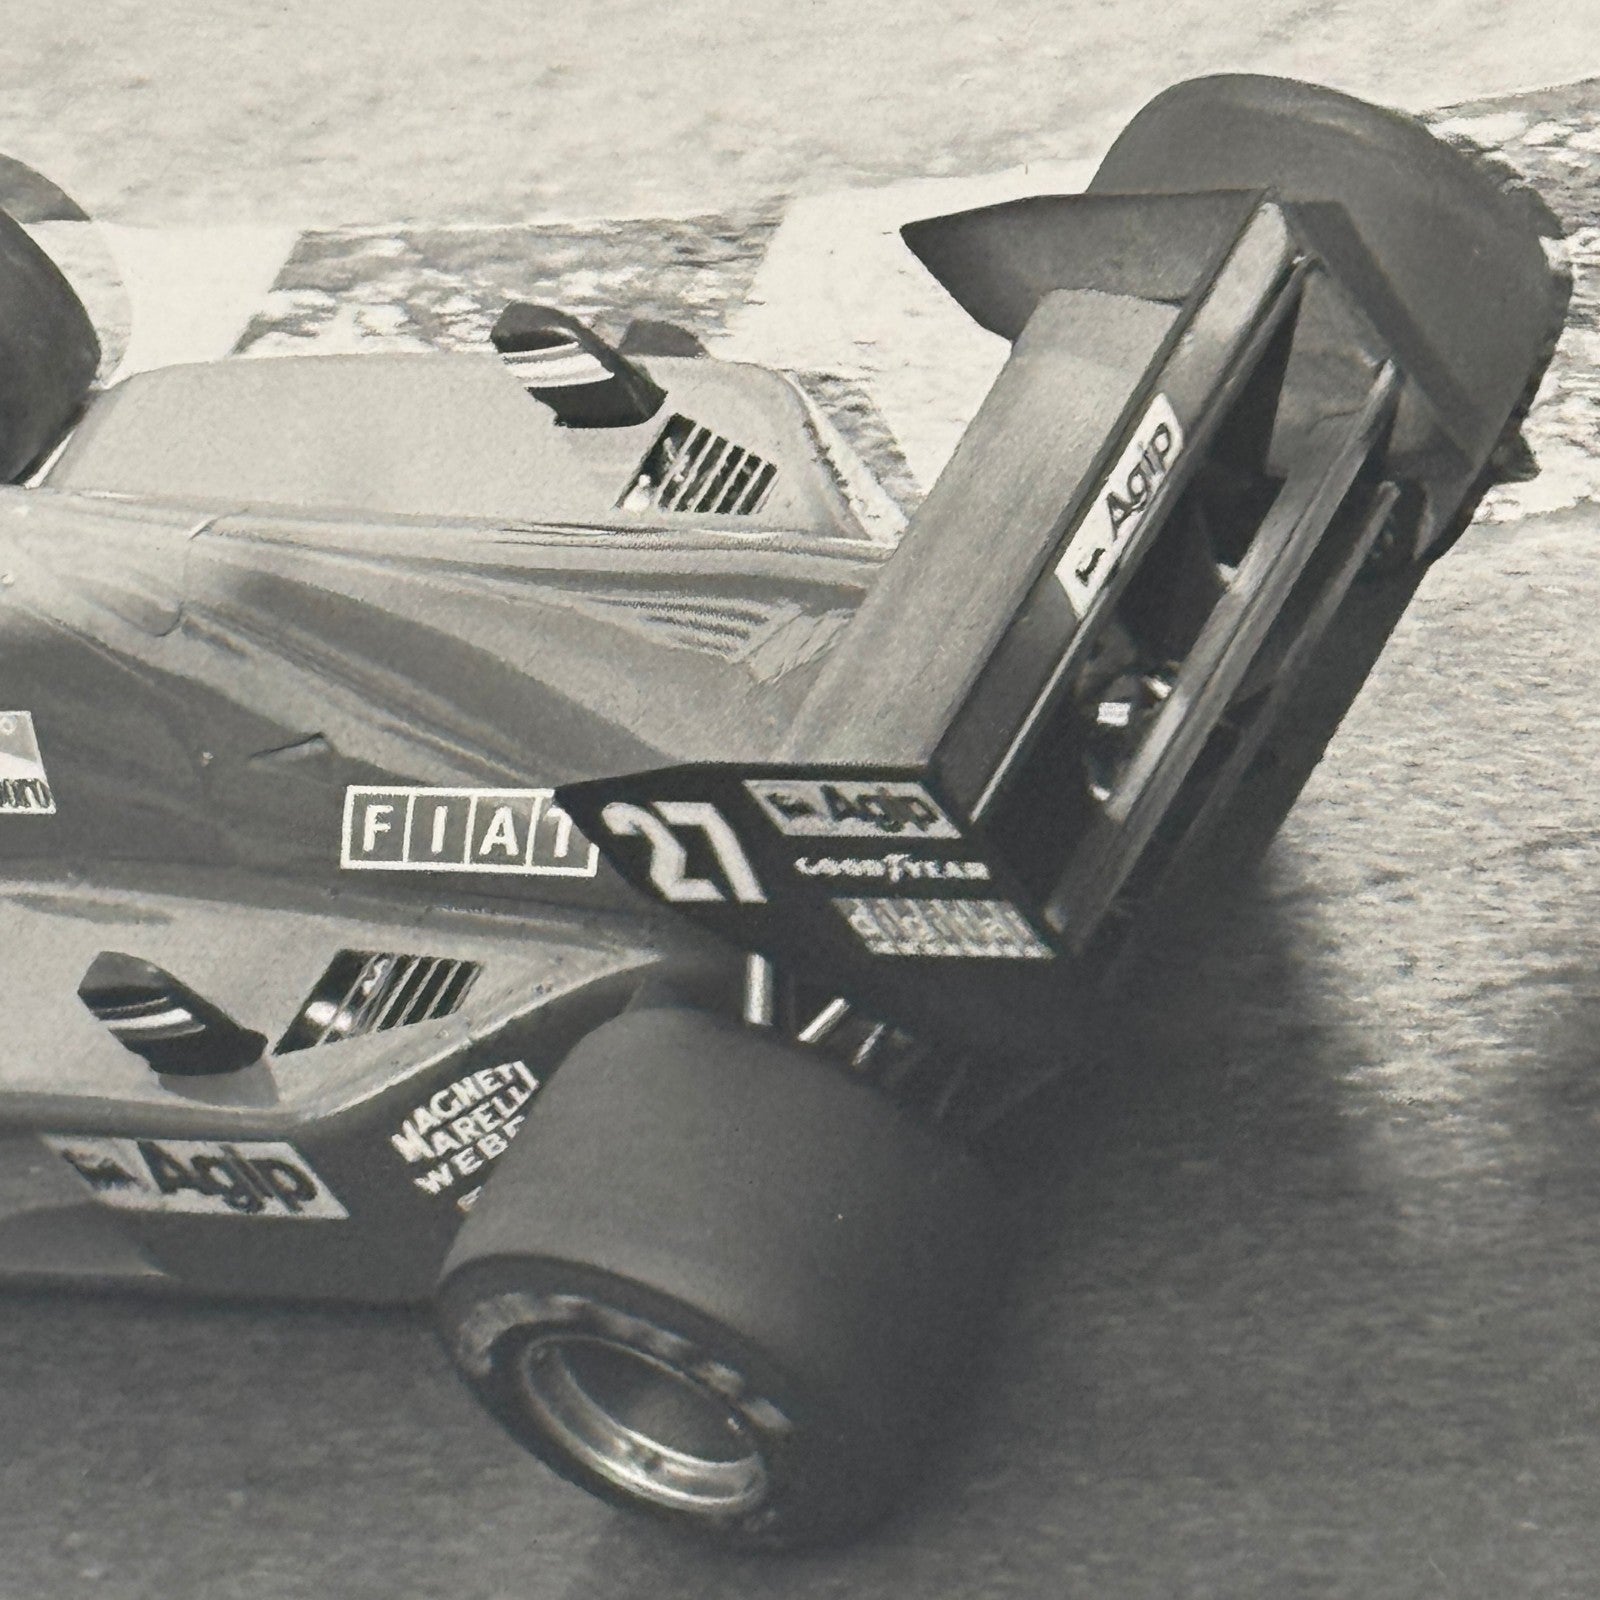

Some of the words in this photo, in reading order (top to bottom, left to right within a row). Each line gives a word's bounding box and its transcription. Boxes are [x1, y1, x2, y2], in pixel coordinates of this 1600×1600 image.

[1106, 421, 1171, 543] Agip
[362, 804, 575, 858] FIAT
[602, 802, 768, 904] 27
[137, 1141, 318, 1213] Agip
